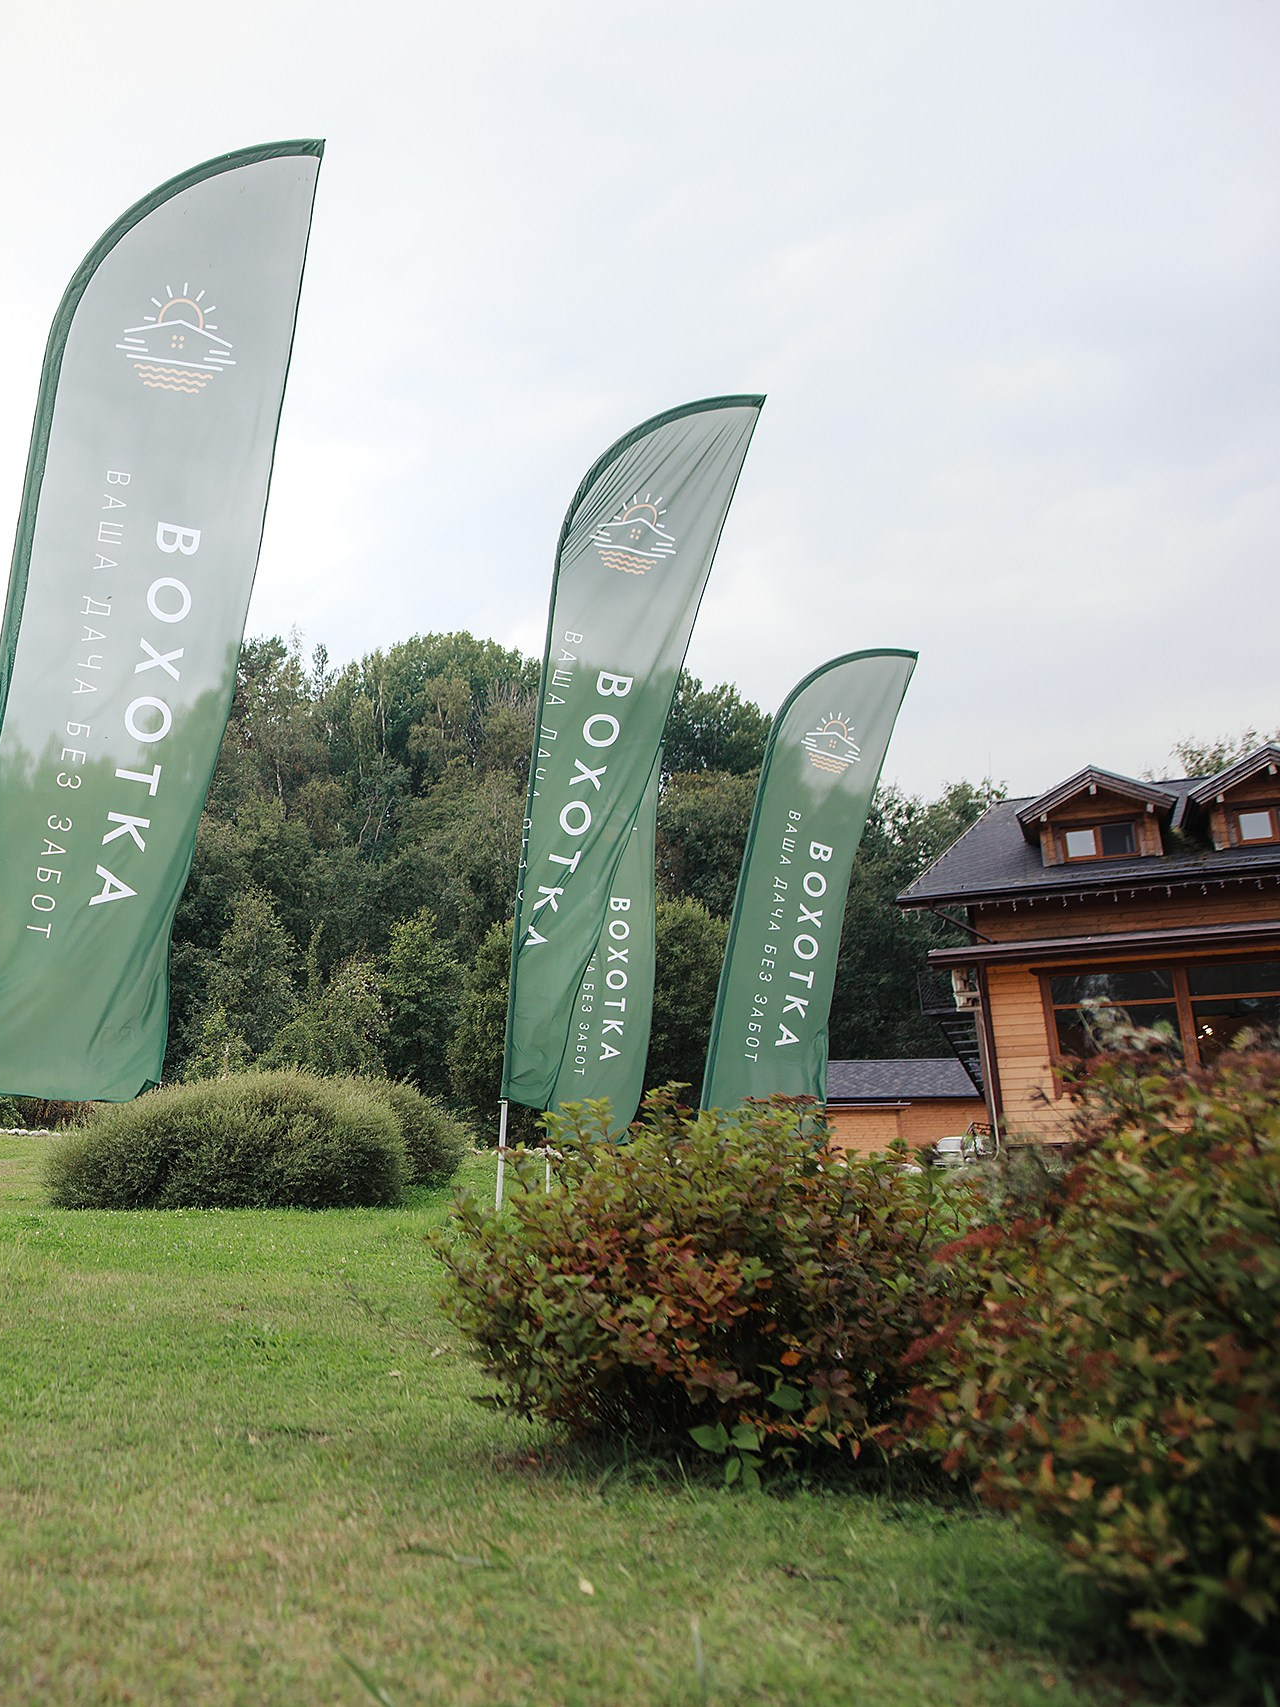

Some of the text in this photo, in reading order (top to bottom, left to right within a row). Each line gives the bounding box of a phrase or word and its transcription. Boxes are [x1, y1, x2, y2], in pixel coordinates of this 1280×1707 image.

[26, 470, 131, 939] ВАША ДАЧА БЕЗ ЗАБОТ
[88, 521, 201, 906] ВОХОТКА
[545, 630, 583, 705] ВАША
[524, 669, 634, 946] ВОХОТКА
[581, 983, 595, 1013] БЕЗ
[599, 897, 631, 1061] ВОХОТКА
[744, 809, 801, 1063] ВАША ДАЧА БЕЗ ЗАБОТ
[774, 840, 833, 1049] ВОХОТКА
[573, 1022, 590, 1076] ЗАБОТ
